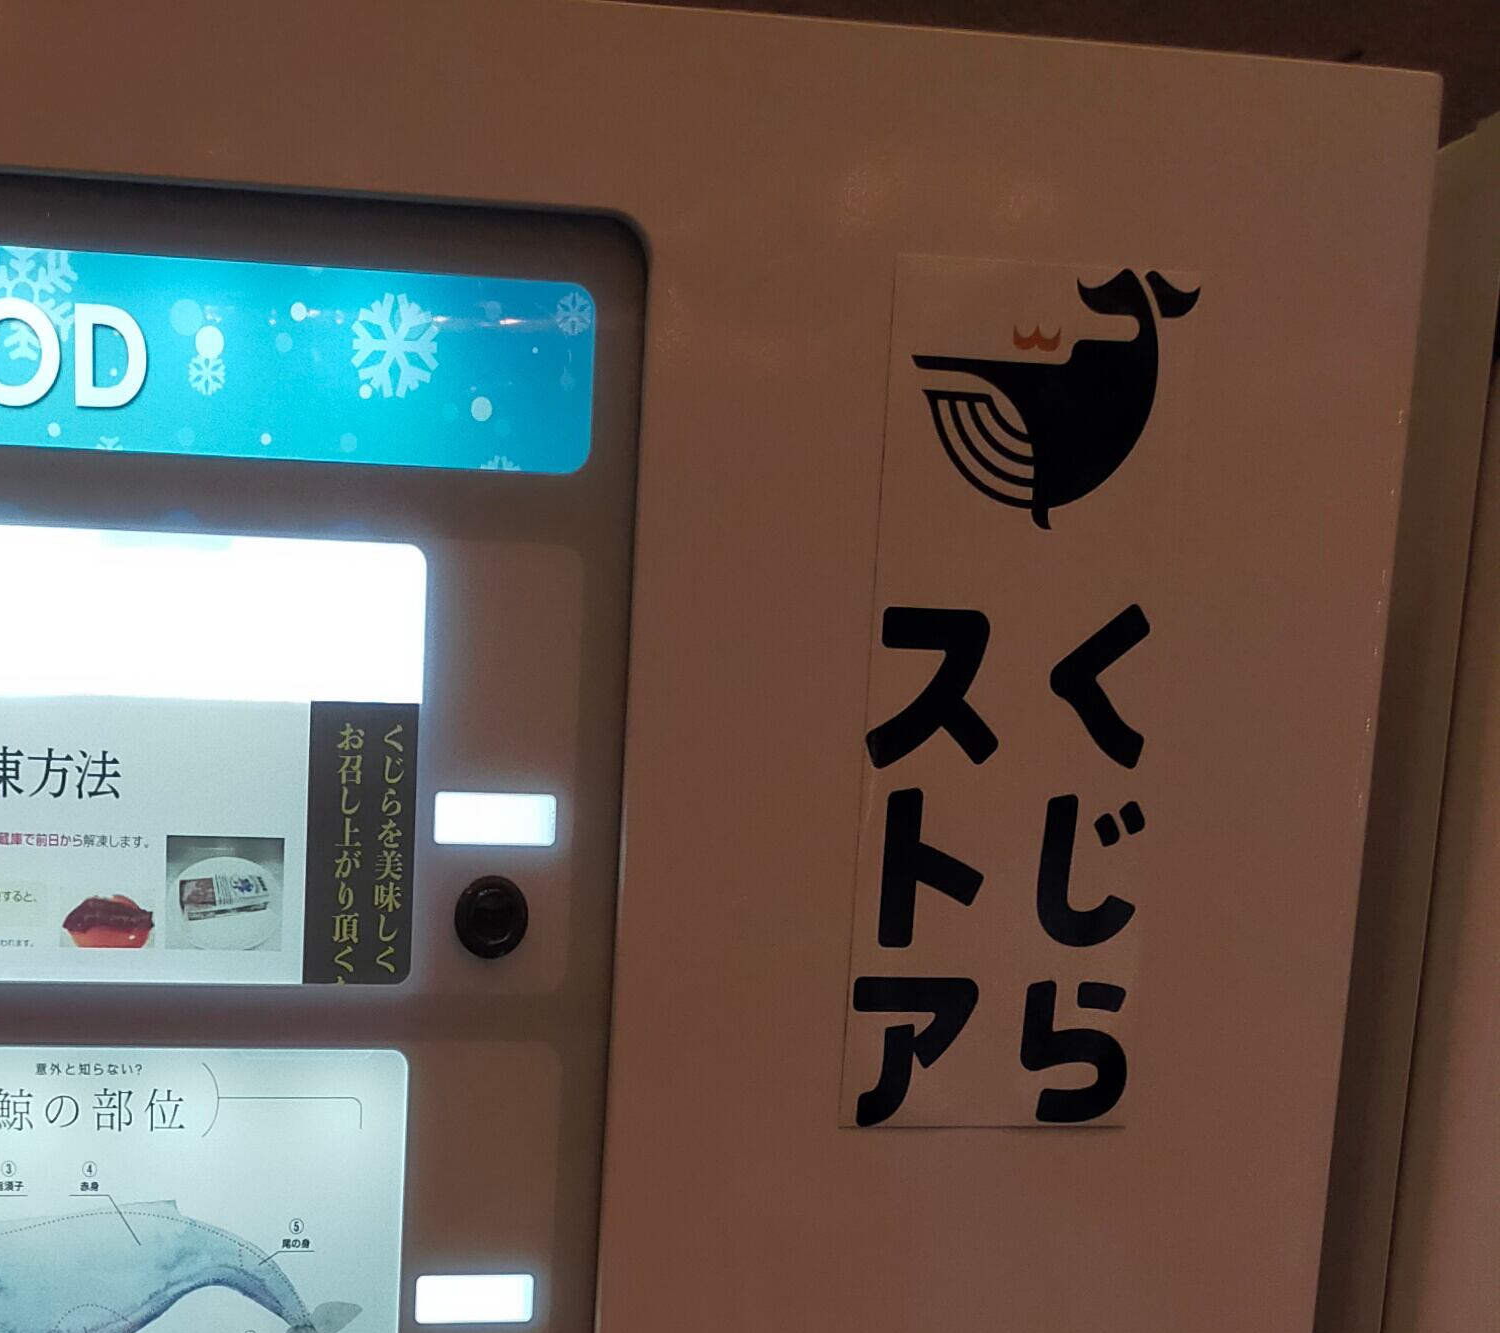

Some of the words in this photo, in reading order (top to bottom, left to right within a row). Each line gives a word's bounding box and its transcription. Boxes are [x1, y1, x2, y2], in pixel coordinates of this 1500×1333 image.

[373, 724, 404, 973] くじらを美味しく
[851, 605, 999, 1128] ストア
[1019, 602, 1151, 1124] くじら
[282, 1239, 310, 1249] 尾の身
